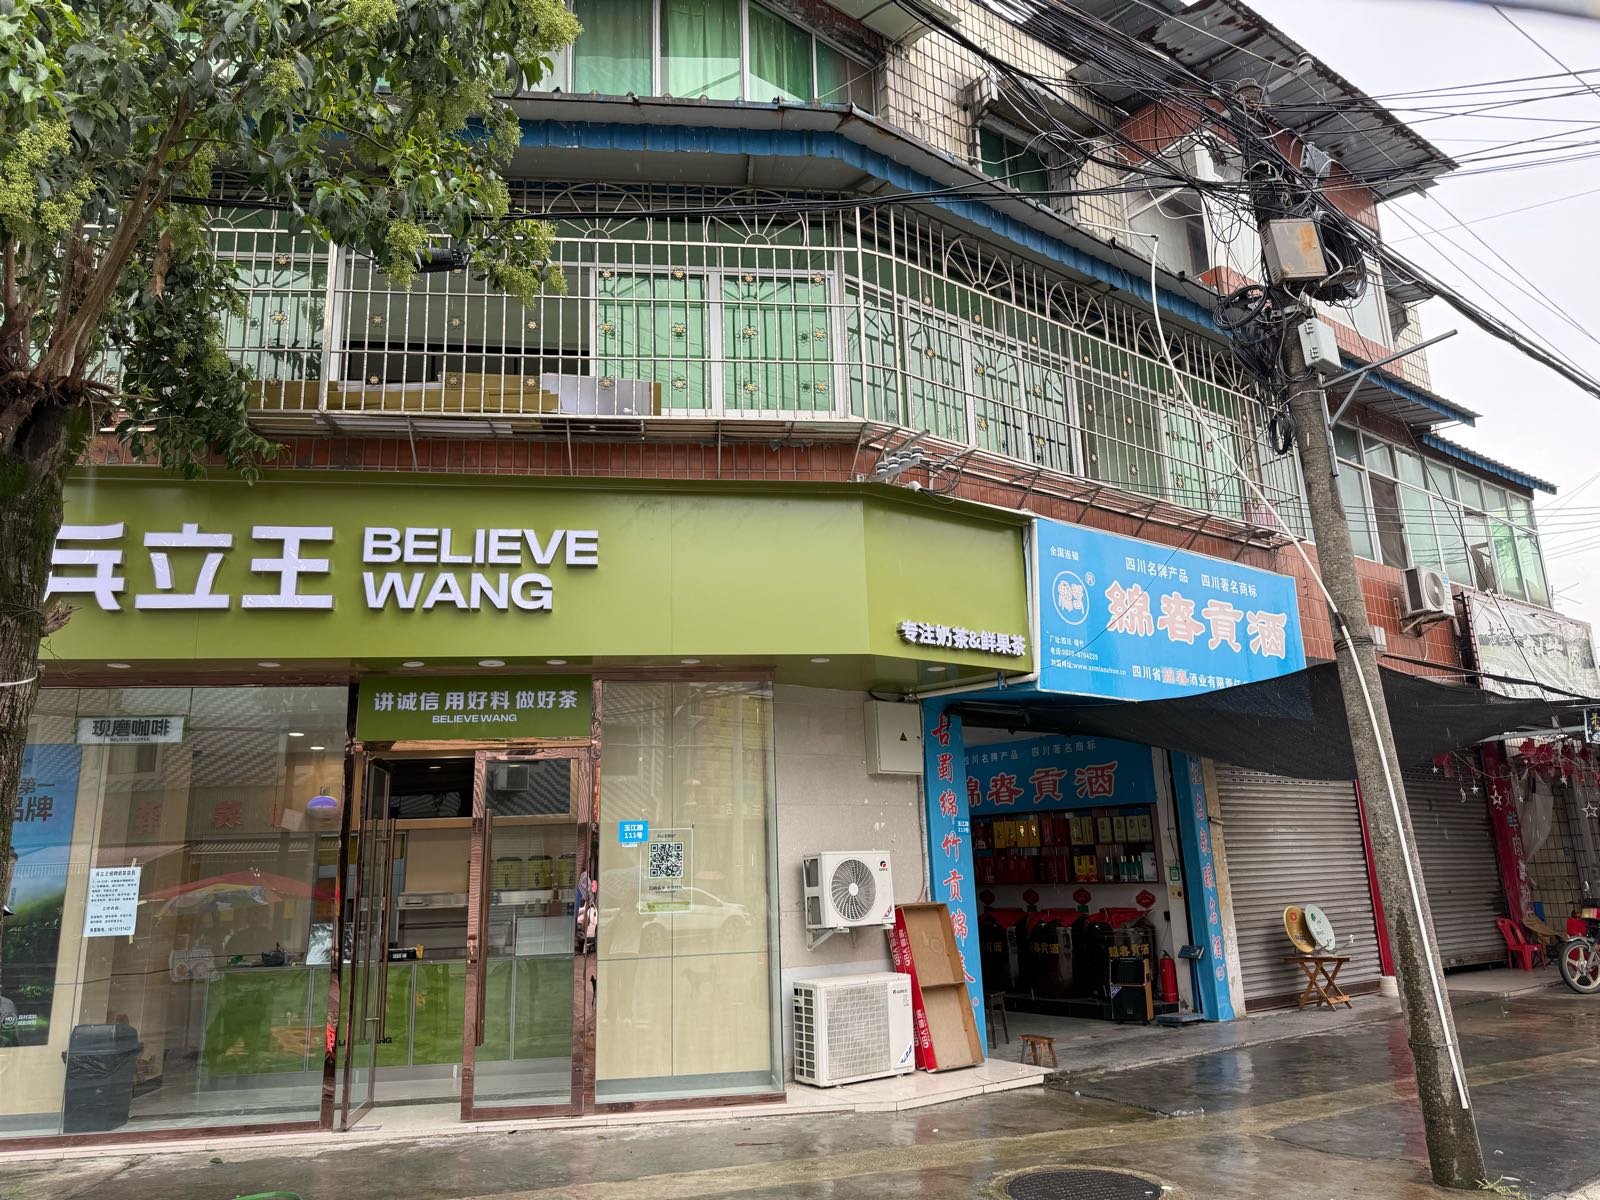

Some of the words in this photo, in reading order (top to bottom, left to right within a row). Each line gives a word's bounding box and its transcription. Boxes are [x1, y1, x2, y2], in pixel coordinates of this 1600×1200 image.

[362, 526, 599, 567] BELIEVE
[362, 571, 553, 612] WANG
[1124, 556, 1189, 584] 四川名牌产品
[1200, 573, 1258, 599] 四川著名商标
[898, 619, 1027, 657] 专注奶茶&鲜果茶
[374, 692, 439, 711] 讲诚信
[444, 691, 511, 710] 用好料
[515, 690, 578, 709] 做好茶
[92, 719, 171, 737] 现磨咖啡
[432, 714, 479, 723] BELIEVE
[480, 713, 518, 722] WANG
[1030, 740, 1098, 758] 四川著名商标
